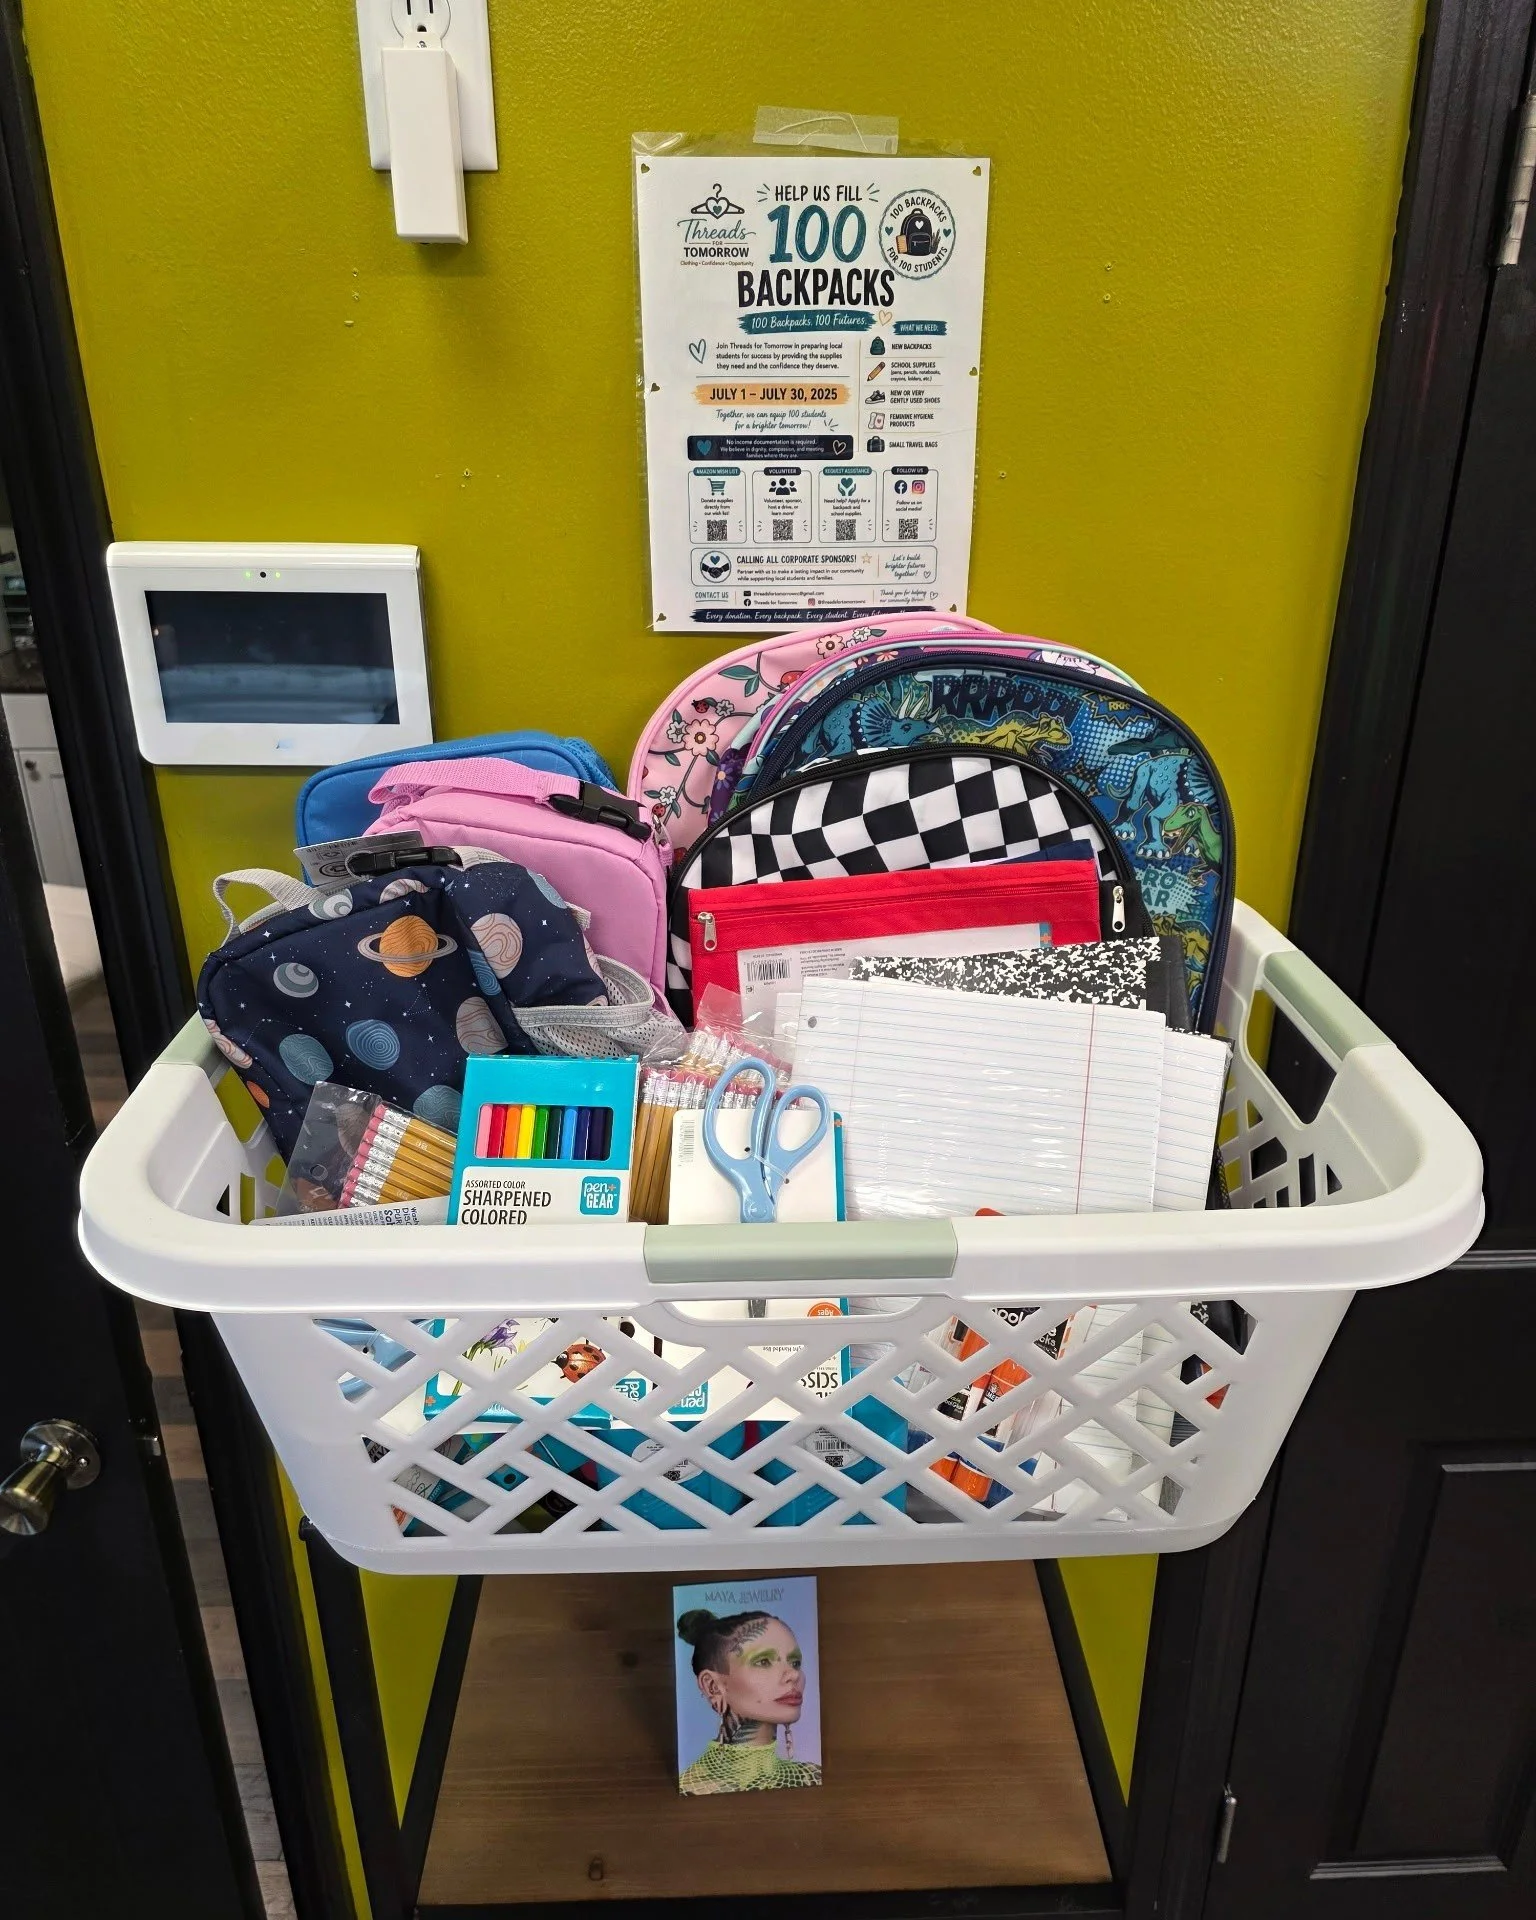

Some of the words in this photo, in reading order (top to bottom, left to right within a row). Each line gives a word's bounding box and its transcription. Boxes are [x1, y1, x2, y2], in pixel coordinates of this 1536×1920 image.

[775, 185, 808, 201] HELP
[814, 185, 830, 201] US
[837, 185, 862, 201] FILL
[890, 204, 903, 219] 100
[905, 197, 946, 222] BACKPACKS
[677, 218, 756, 243] Threads
[767, 204, 866, 263] 100
[684, 247, 749, 257] TOMORROW
[887, 247, 899, 263] FOR
[899, 260, 911, 271] 100
[914, 247, 947, 272] STUDENTS
[738, 267, 895, 308] BACKPACKS
[752, 316, 768, 329] 100
[770, 315, 813, 330] Backpacks.
[815, 314, 831, 326] 100
[833, 313, 867, 326] Futures.
[900, 324, 914, 332] WHAT
[916, 324, 924, 332] WE
[924, 323, 939, 332] NEED:
[774, 352, 780, 360] by
[782, 352, 807, 360] providing
[820, 352, 842, 360] supplies
[710, 388, 737, 400] JULY
[741, 389, 746, 400] 1
[760, 388, 787, 400] JULY
[791, 388, 807, 402] 30,
[811, 388, 837, 400] 2025
[716, 409, 744, 422] Together,
[770, 411, 786, 421] equip
[735, 421, 744, 431] for
[752, 421, 776, 432] brighter
[779, 420, 811, 429] tomorrow!
[737, 556, 764, 564] CALLING
[821, 555, 856, 563] SPONSORS!
[895, 570, 917, 579] together!
[706, 612, 723, 621] Every
[725, 611, 752, 619] donation.
[755, 612, 772, 621] Every
[774, 611, 801, 620] backpack.
[806, 612, 823, 621] Every
[1143, 868, 1177, 890] RO
[1142, 887, 1170, 907] AR
[466, 1180, 501, 1189] ASSORTED
[503, 1180, 525, 1189] COLOR
[463, 1190, 551, 1207] SHARPENED
[586, 1194, 613, 1208] GEAR
[462, 1209, 527, 1225] COLORED
[818, 1308, 834, 1317] Ages
[705, 1591, 736, 1604] MAYA
[739, 1588, 784, 1604] JEWELRY
